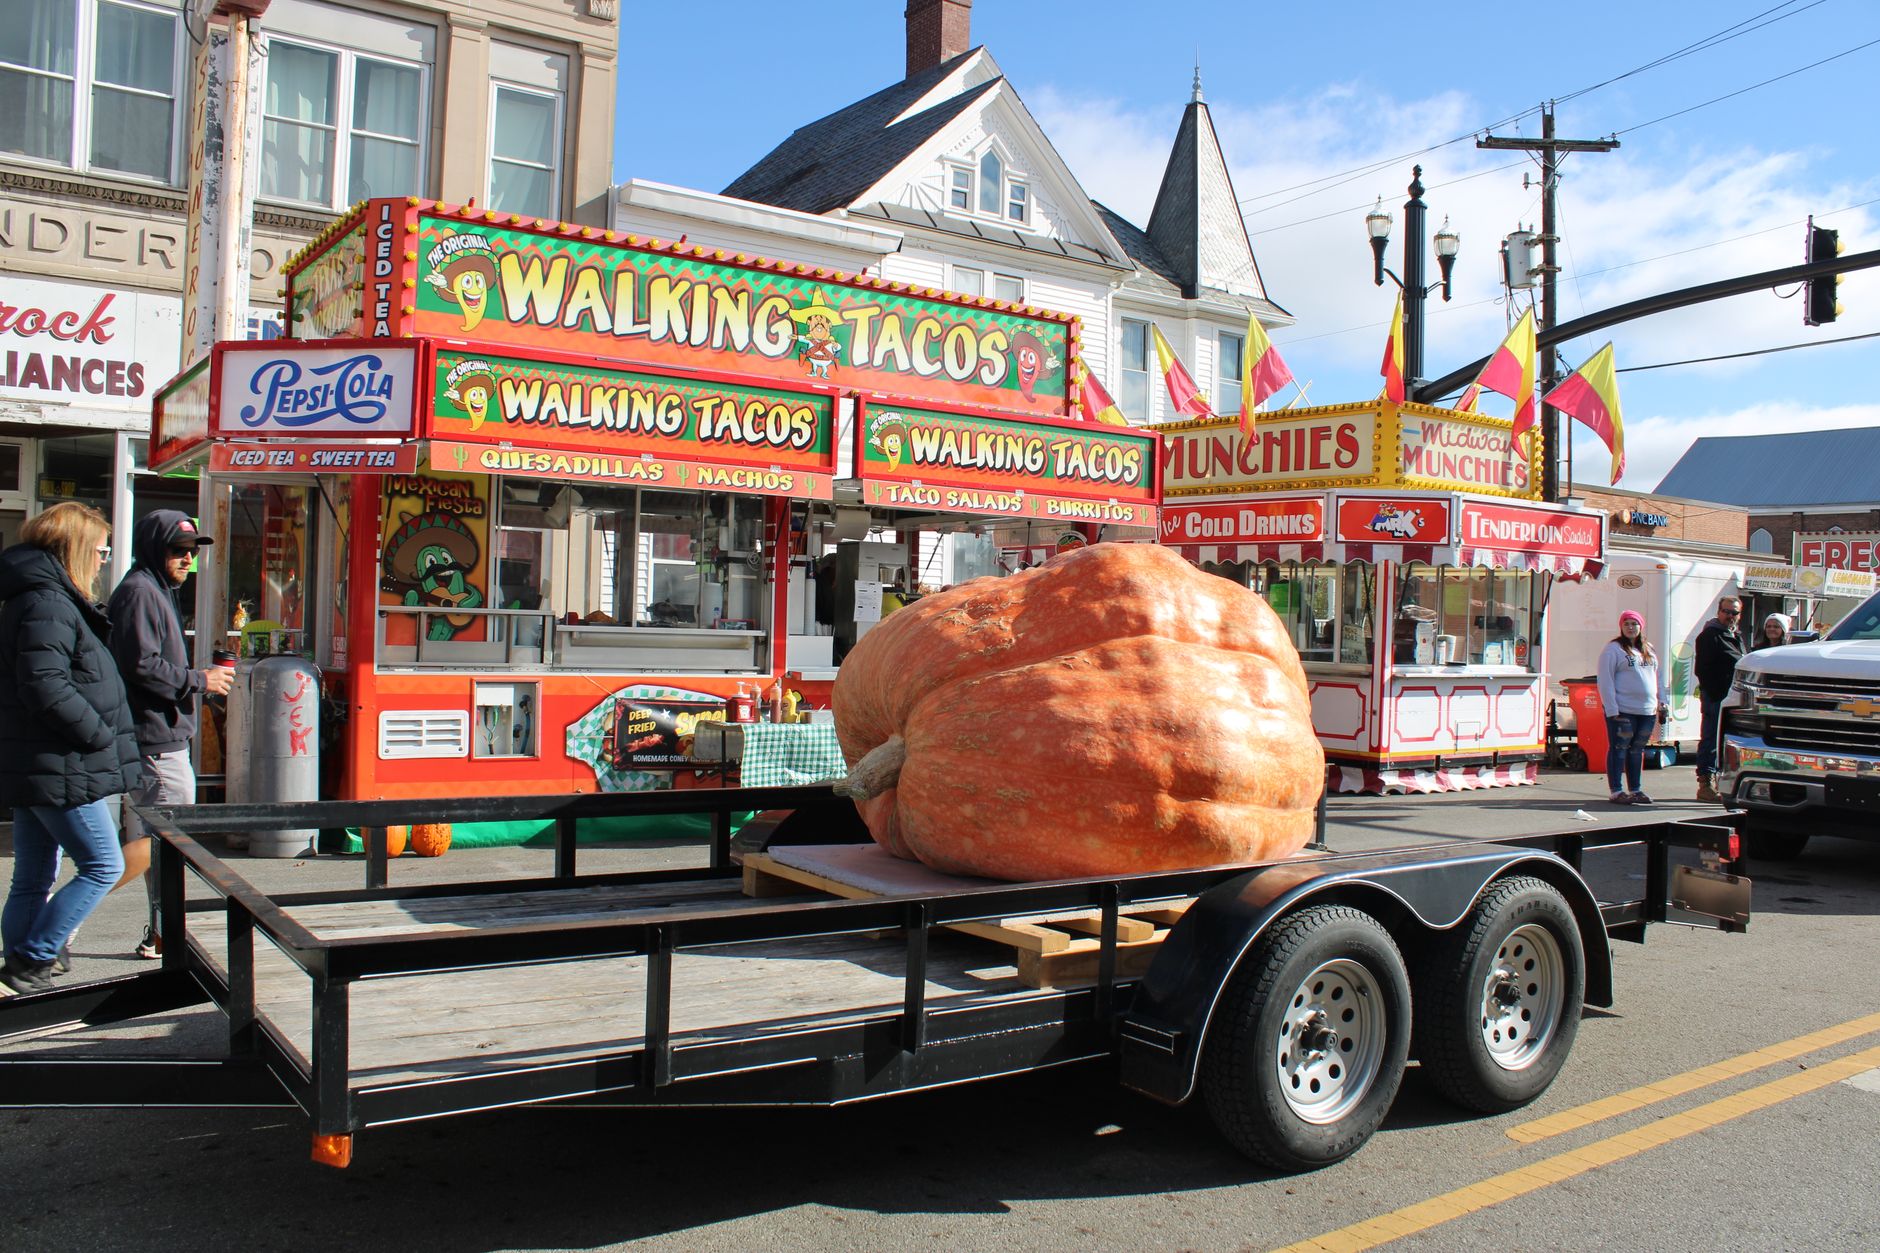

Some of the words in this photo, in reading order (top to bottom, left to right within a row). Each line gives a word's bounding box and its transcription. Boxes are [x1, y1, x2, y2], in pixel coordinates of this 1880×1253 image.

[375, 204, 394, 277] ICED
[427, 243, 446, 270] THE
[442, 234, 492, 255] ORIGINAL
[373, 283, 392, 338] TEA
[500, 252, 794, 359] WALKING
[842, 305, 1008, 386] TACOS
[446, 368, 459, 387] THE
[456, 360, 491, 376] ORIGINAL
[500, 378, 683, 435] WALKING
[694, 397, 815, 448] TACOS
[229, 450, 266, 465] ICED
[268, 451, 294, 465] TEA
[310, 450, 364, 466] SWEET
[366, 451, 396, 466] TEA
[910, 427, 1045, 474] WALKING
[1052, 441, 1143, 483] TACOS
[1164, 423, 1359, 480] MUNCHIES
[1421, 421, 1512, 461] Midway
[480, 449, 664, 481] QUESADILLAS
[696, 467, 794, 491] NACHOS
[1403, 444, 1528, 488] MUNCHIES
[885, 485, 941, 506] TACO
[946, 491, 1022, 512] SALADS
[1046, 499, 1134, 522] BURRITOS
[1631, 511, 1648, 526] PNC
[1648, 513, 1668, 527] BANK
[1745, 566, 1793, 579] LEMONADE
[1832, 572, 1873, 586] LEMONADE
[628, 721, 657, 735] FRIED
[629, 709, 652, 721] DEEP
[633, 754, 669, 763] HOMEMADE
